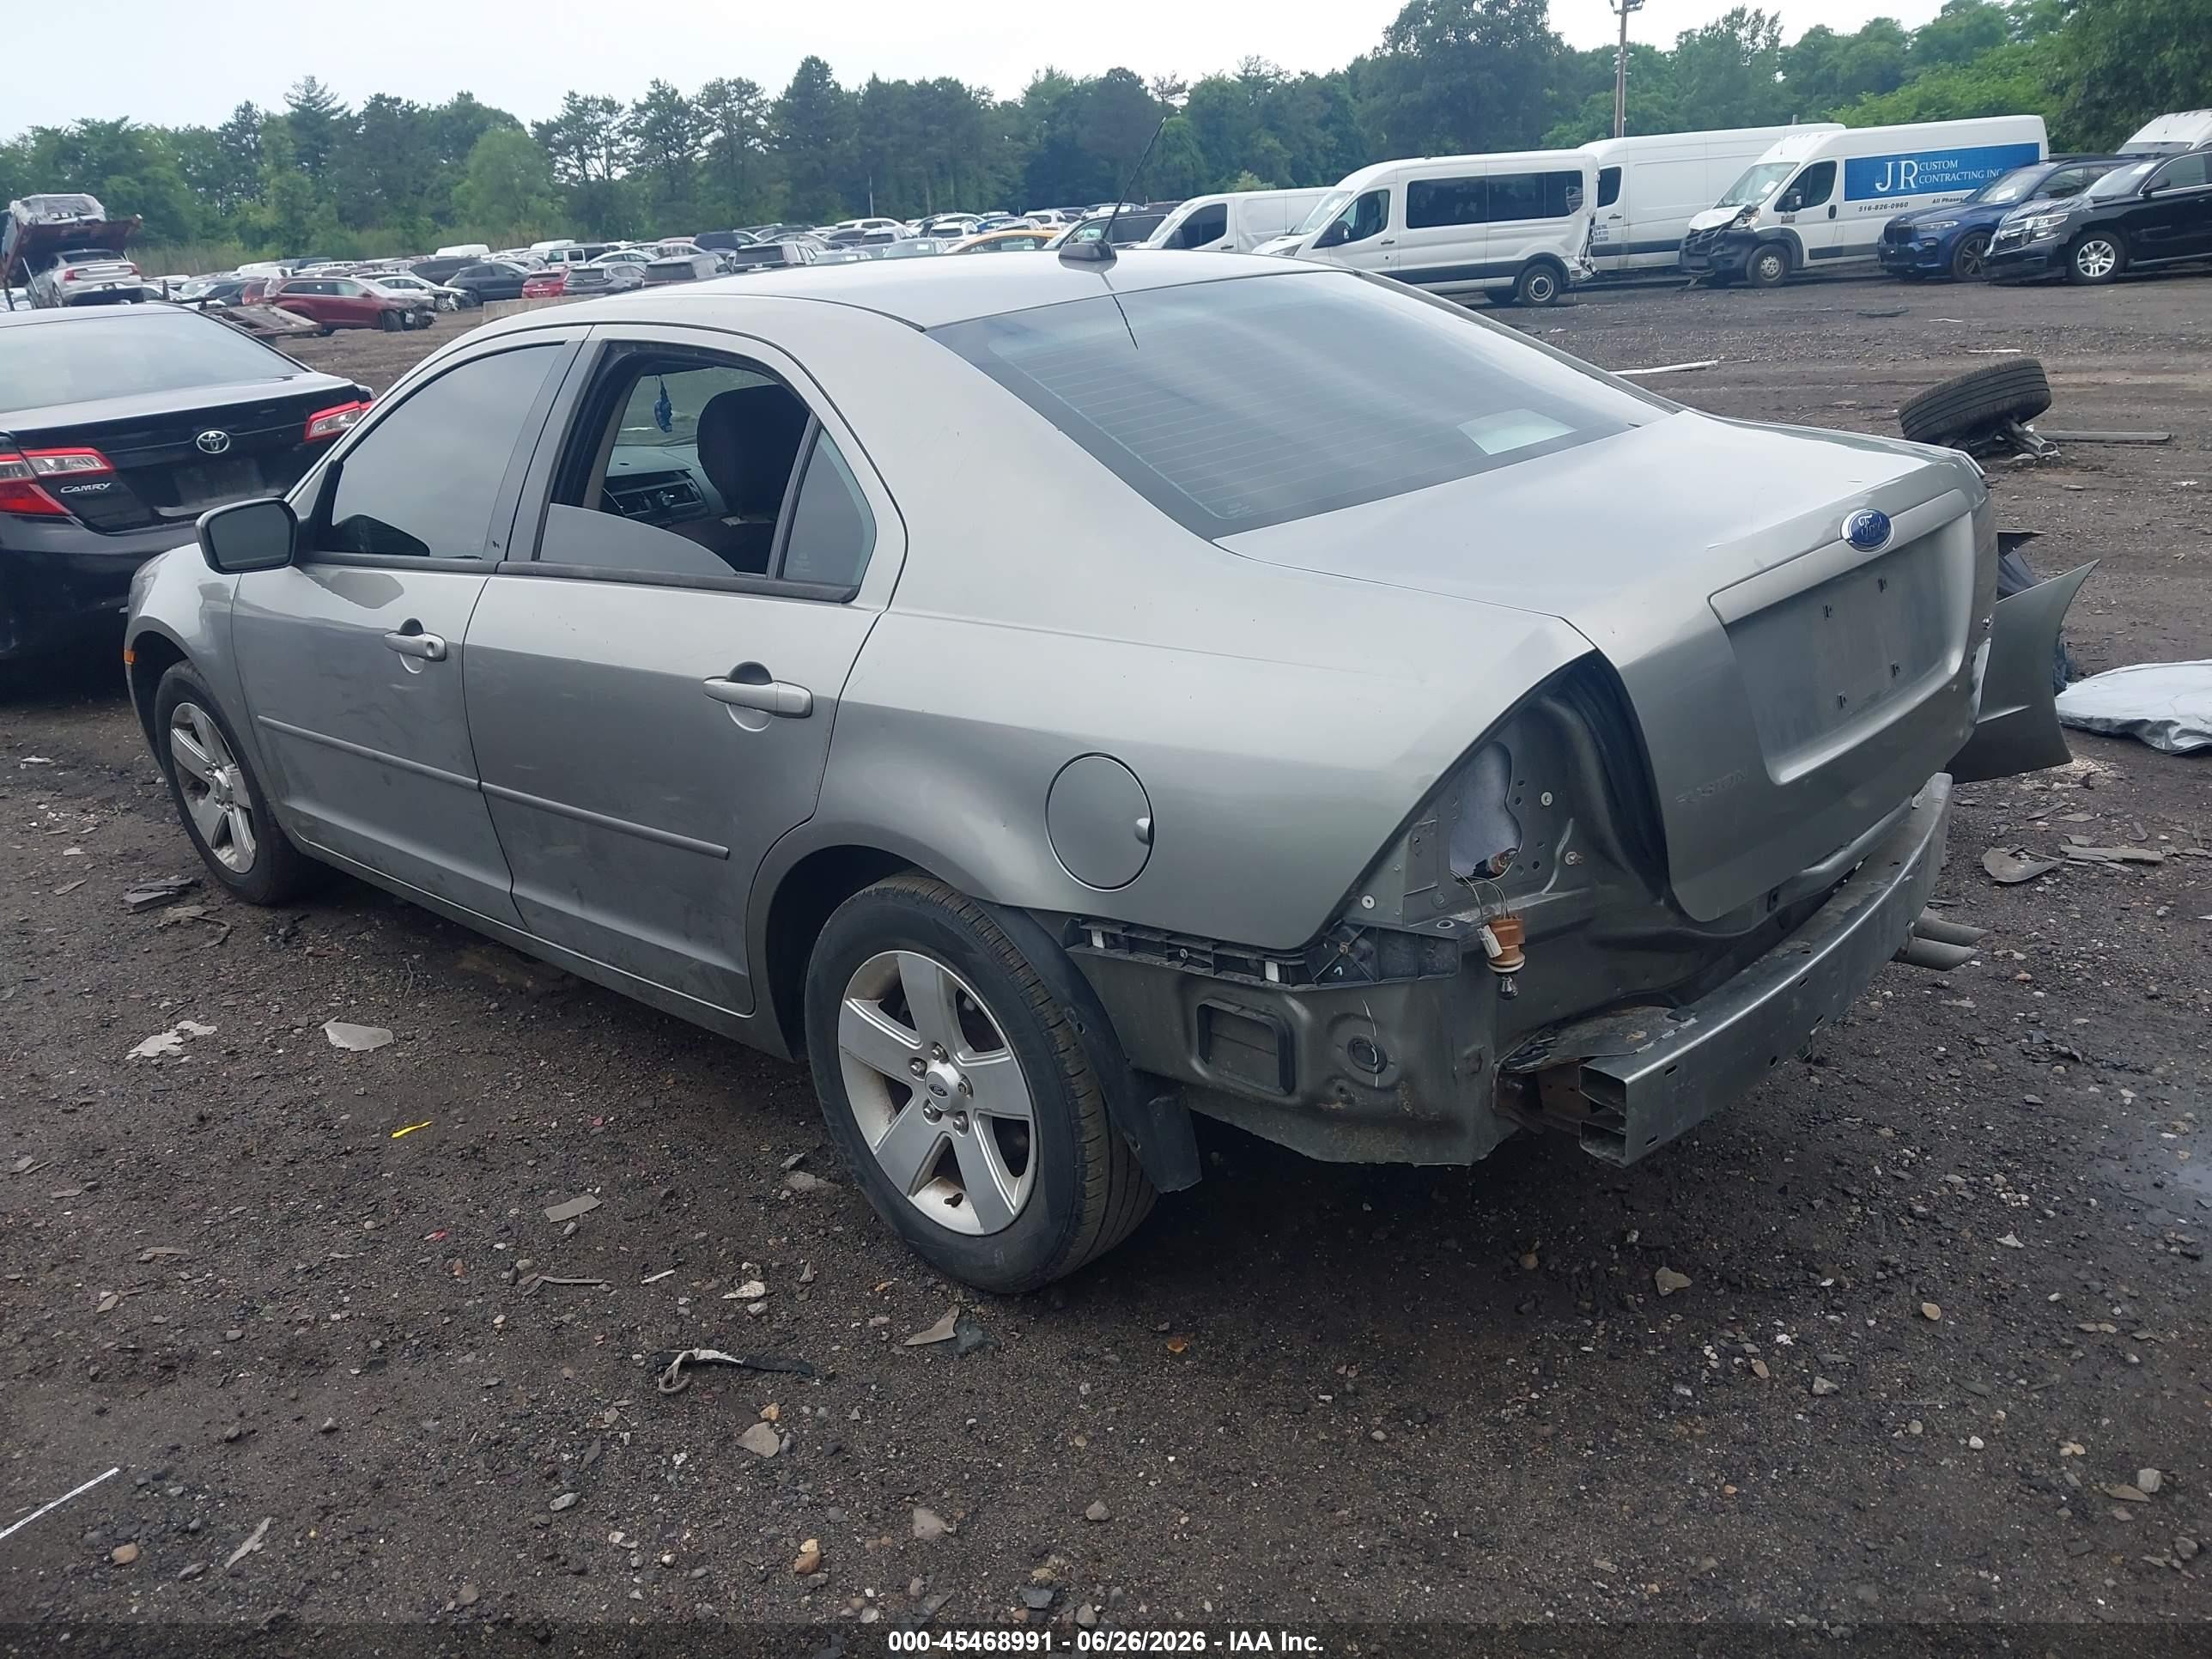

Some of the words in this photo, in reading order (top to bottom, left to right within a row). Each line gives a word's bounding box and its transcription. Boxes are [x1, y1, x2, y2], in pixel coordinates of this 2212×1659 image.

[1919, 160, 1958, 171] CUSTOM
[1918, 170, 1984, 185] CONTRACTING
[60, 483, 112, 494] CAMRY
